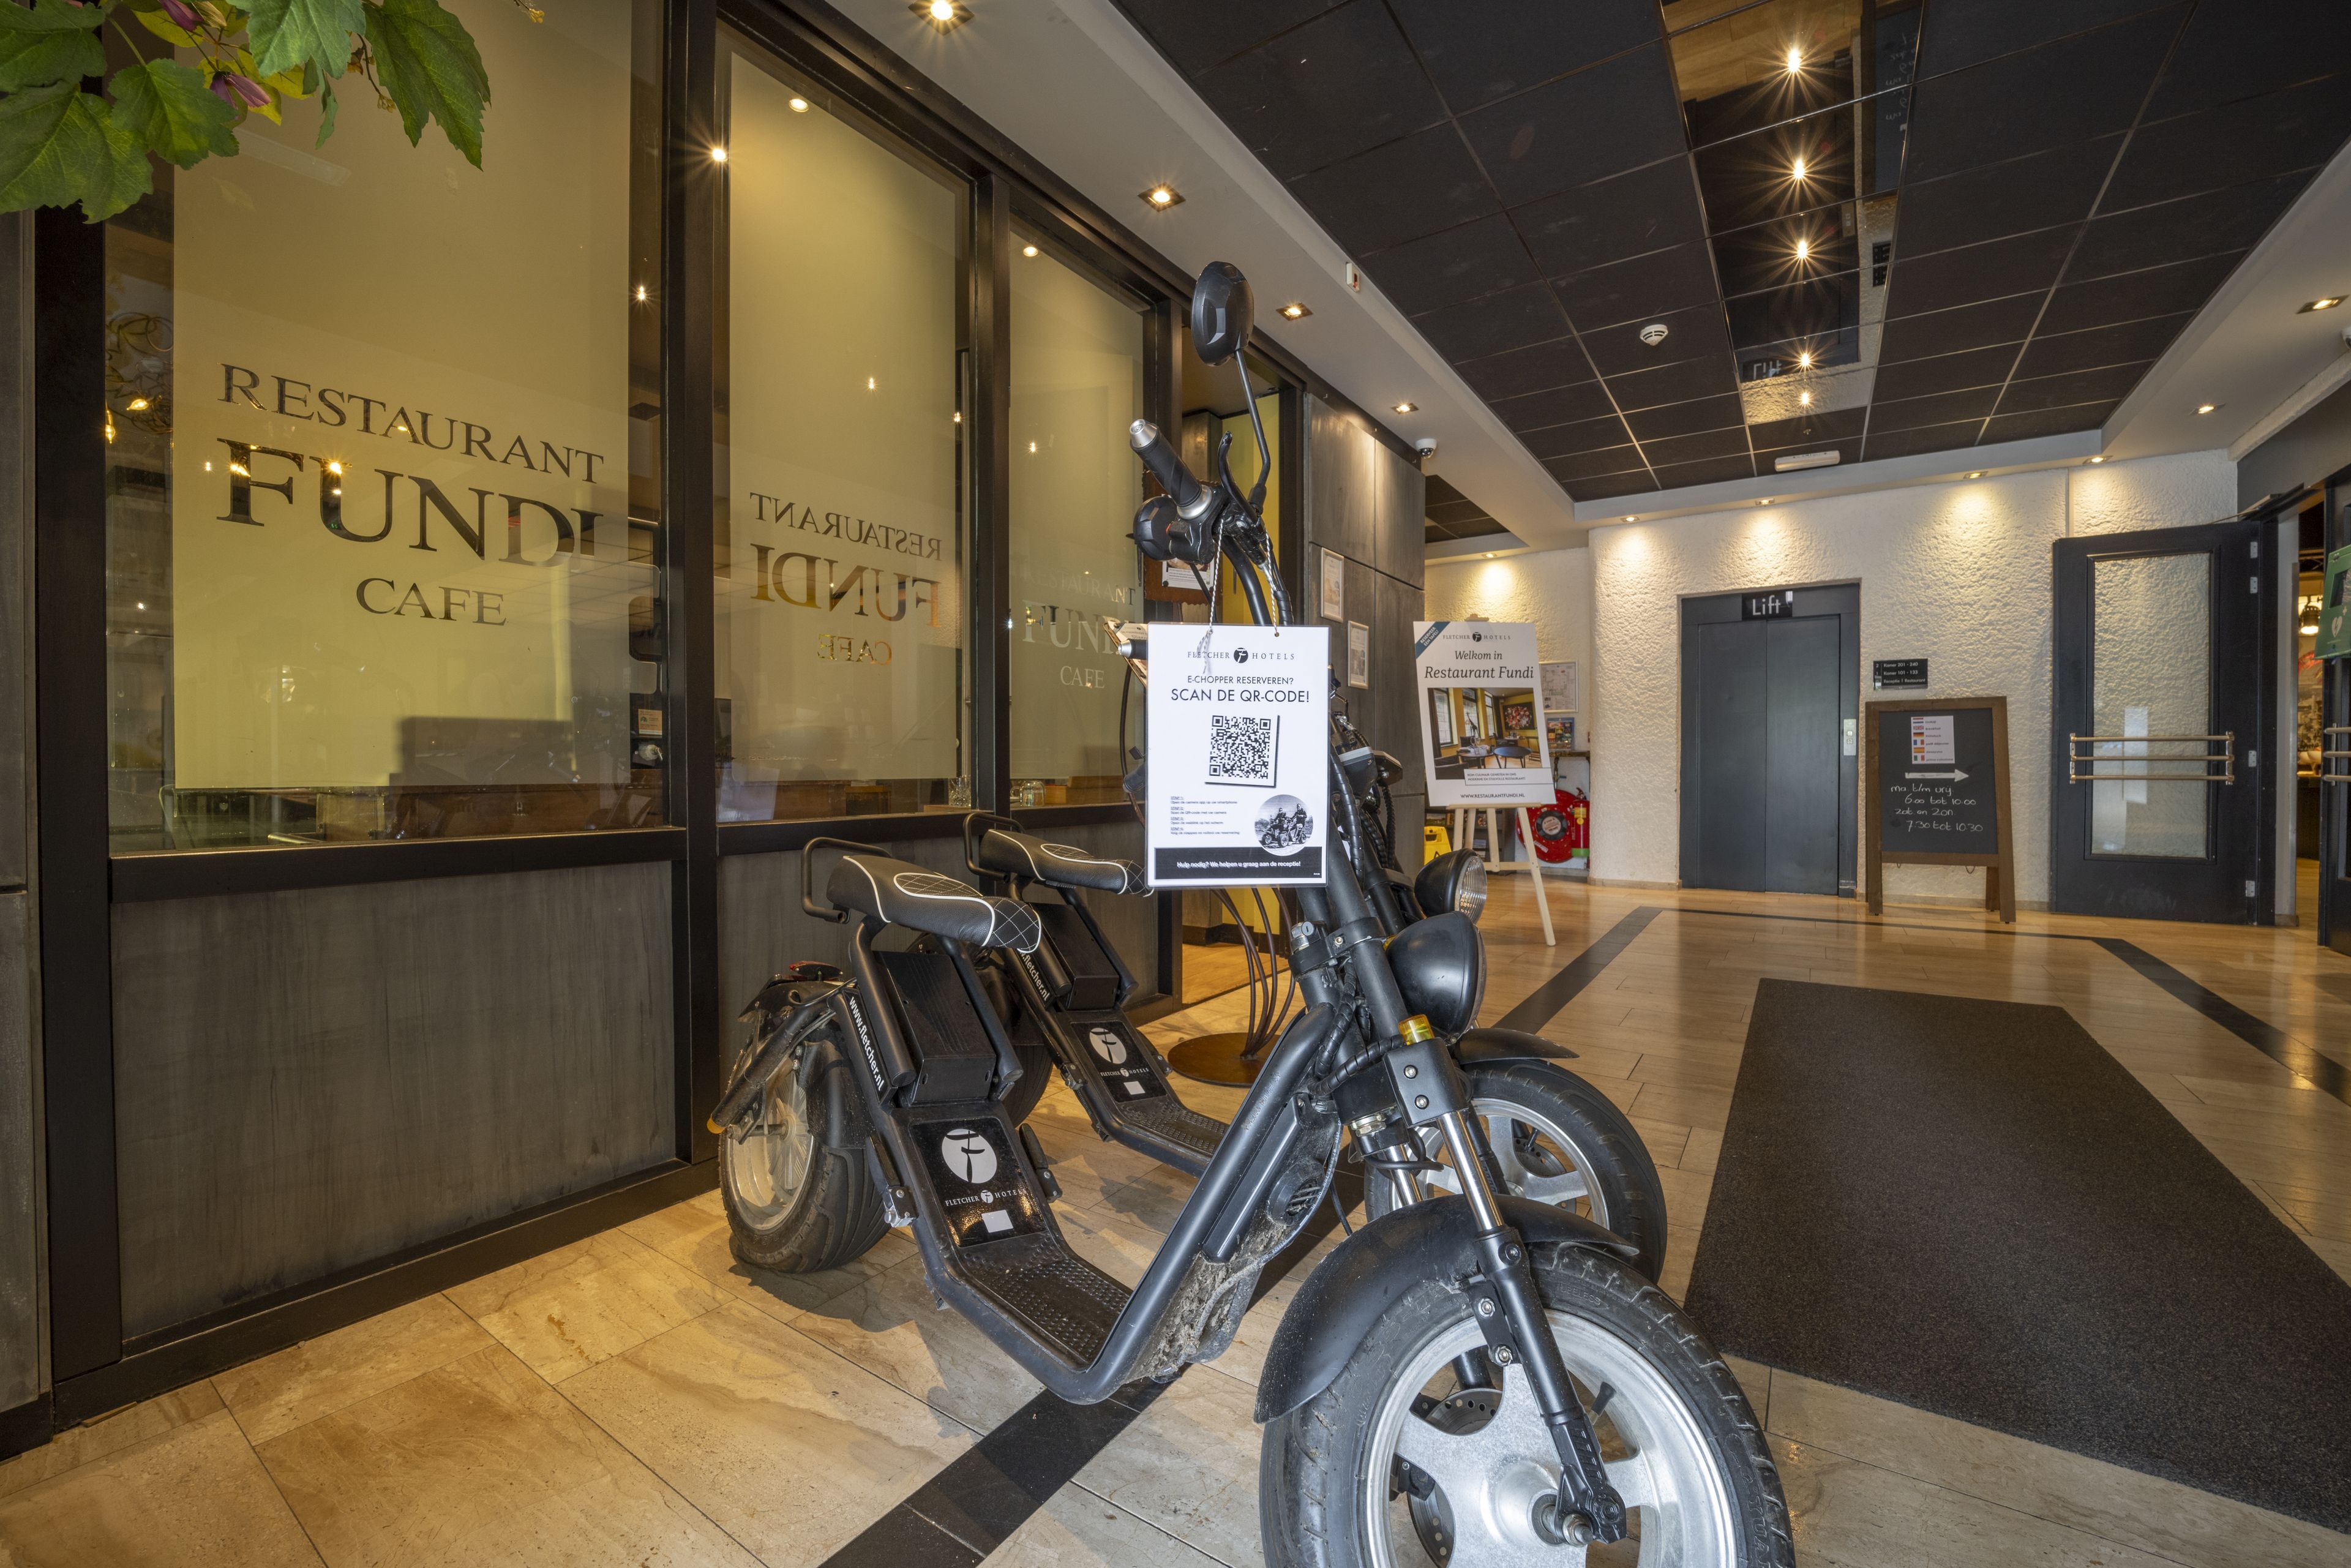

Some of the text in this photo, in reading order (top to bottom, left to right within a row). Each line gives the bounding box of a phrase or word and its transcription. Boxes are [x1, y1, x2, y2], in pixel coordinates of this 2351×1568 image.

[217, 362, 604, 484] RESTAURANT
[217, 438, 603, 572] FUNDI
[356, 578, 506, 626] CAFE
[1752, 595, 1781, 615] Lift
[1455, 651, 1502, 660] Welkom in
[1060, 666, 1104, 688] CAFE
[1424, 666, 1534, 678] Restaurant Fundi
[1171, 689, 1310, 703] SCAN DE QR-CODE!
[1933, 821, 1951, 831] tot
[1956, 823, 1983, 831] 10.30
[1019, 952, 1049, 1001] .fletcher.nl
[849, 997, 884, 1091] www.fletcher.nl
[945, 1196, 980, 1206] FLETCHER
[995, 1188, 1027, 1198] HOTELS
